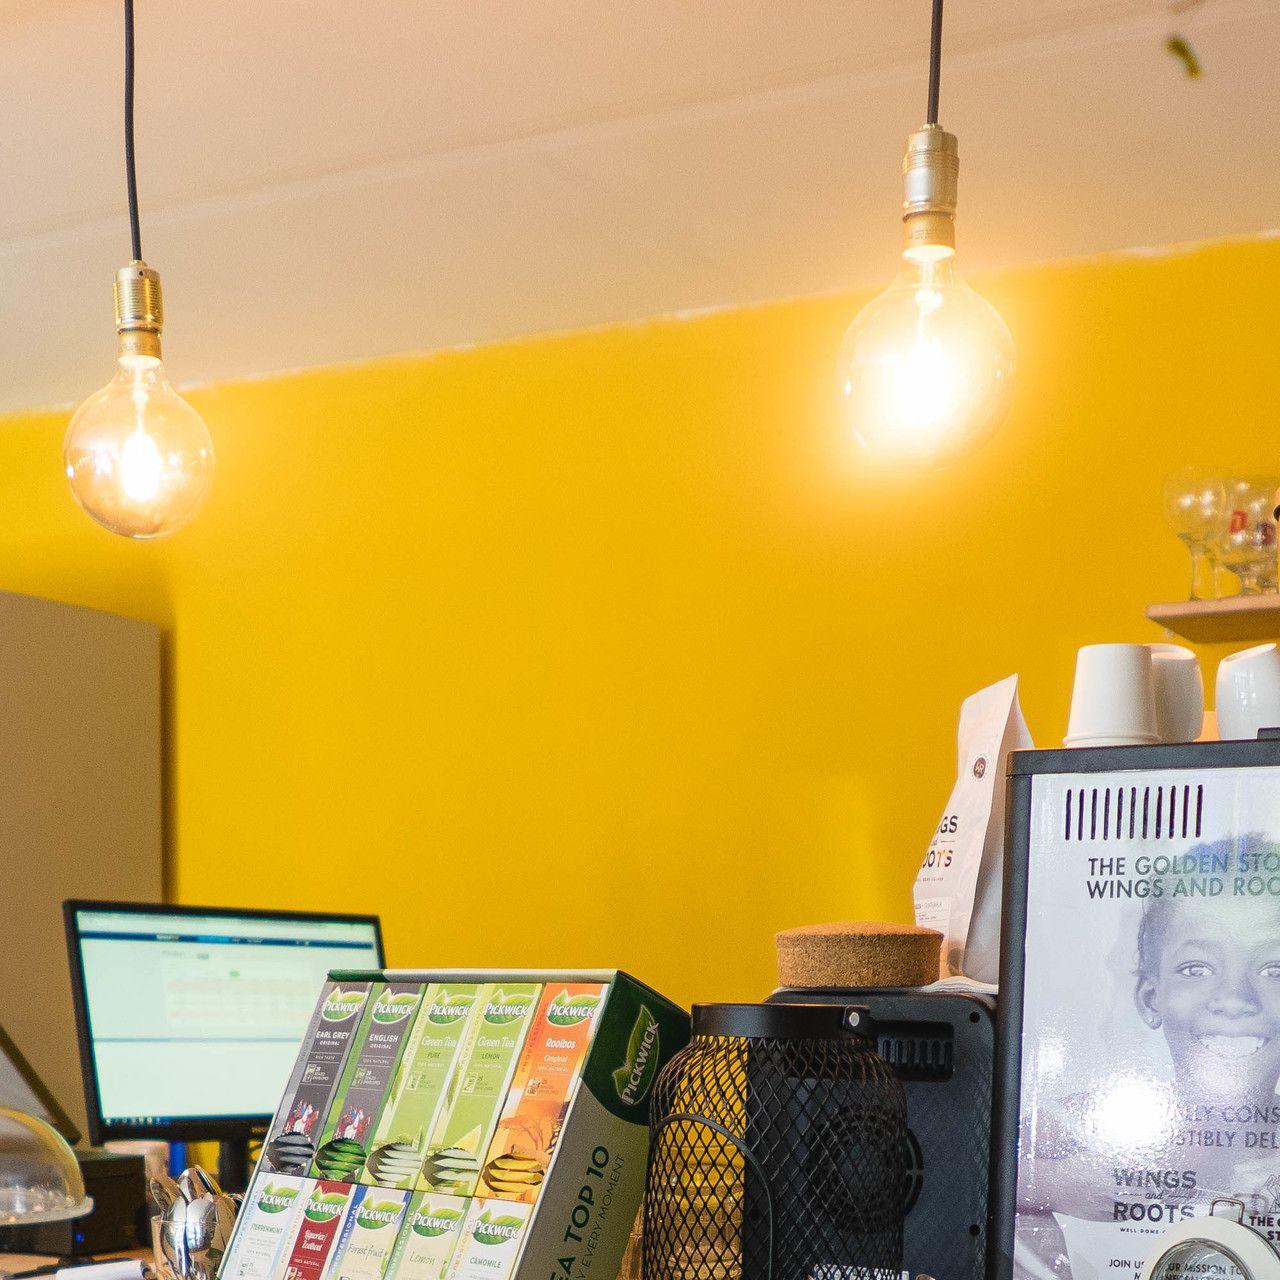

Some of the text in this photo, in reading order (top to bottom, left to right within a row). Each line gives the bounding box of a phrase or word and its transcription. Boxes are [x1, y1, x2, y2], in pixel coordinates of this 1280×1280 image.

[936, 814, 959, 834] GS
[1087, 856, 1126, 877] THE
[1134, 853, 1229, 876] GOLDEN
[1086, 878, 1164, 900] WINGS
[1172, 876, 1224, 899] AND
[321, 1000, 362, 1014] PICKWICK
[372, 1001, 413, 1016] PICKWICK
[427, 1003, 471, 1017] PICKWICK
[483, 1003, 529, 1018] PICKWICK
[546, 1003, 596, 1019] PICKWICK
[316, 1030, 350, 1040] EARL GREY
[369, 1033, 399, 1043] ENGLISH
[422, 1035, 444, 1048] Green
[477, 1036, 501, 1048] Green
[545, 1038, 577, 1049] Rooibos
[621, 1019, 660, 1106] PICKWICK
[1112, 1166, 1198, 1190] WINGS
[256, 1191, 295, 1209] PICKWICK
[563, 1187, 595, 1246] TOP
[589, 1144, 611, 1181] 10
[1144, 1189, 1165, 1200] and
[303, 1197, 344, 1216] PICKWICK
[582, 1218, 606, 1267] EVERY
[599, 1153, 627, 1221] MOMENT
[1112, 1200, 1196, 1224] ROOTS
[355, 1205, 398, 1225] PICKWICK
[410, 1212, 458, 1232] PICKWICK
[1248, 1215, 1275, 1228] THE
[472, 1218, 520, 1240] PICKWICK
[1119, 1226, 1138, 1234] WELL
[409, 1251, 436, 1266] Lemon
[469, 1256, 502, 1269] CAMOMILE
[1108, 1258, 1132, 1269] JOIN
[1183, 1262, 1224, 1275] MISSION
